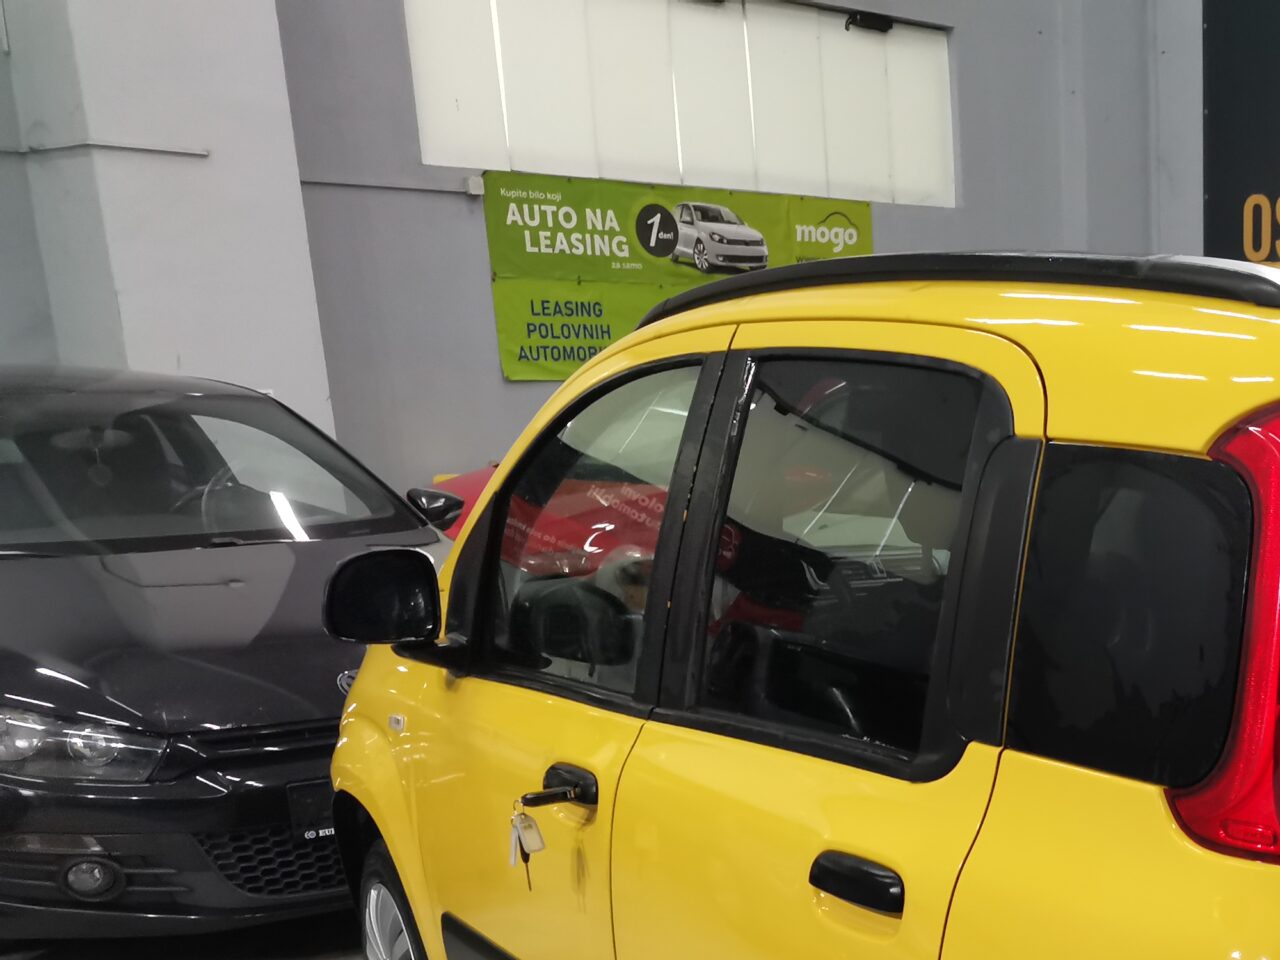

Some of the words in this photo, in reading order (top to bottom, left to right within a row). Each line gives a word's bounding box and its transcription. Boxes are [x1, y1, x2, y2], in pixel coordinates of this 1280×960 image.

[500, 187, 528, 200] Kupite
[528, 190, 546, 200] bilo
[546, 191, 562, 202] koji
[506, 203, 578, 229] AUTO
[585, 208, 621, 232] NA
[647, 212, 662, 247] 1
[524, 229, 630, 258] LEASING
[795, 224, 858, 253] mogo
[530, 299, 603, 318] LEASING
[526, 322, 612, 340] POLOVNIH
